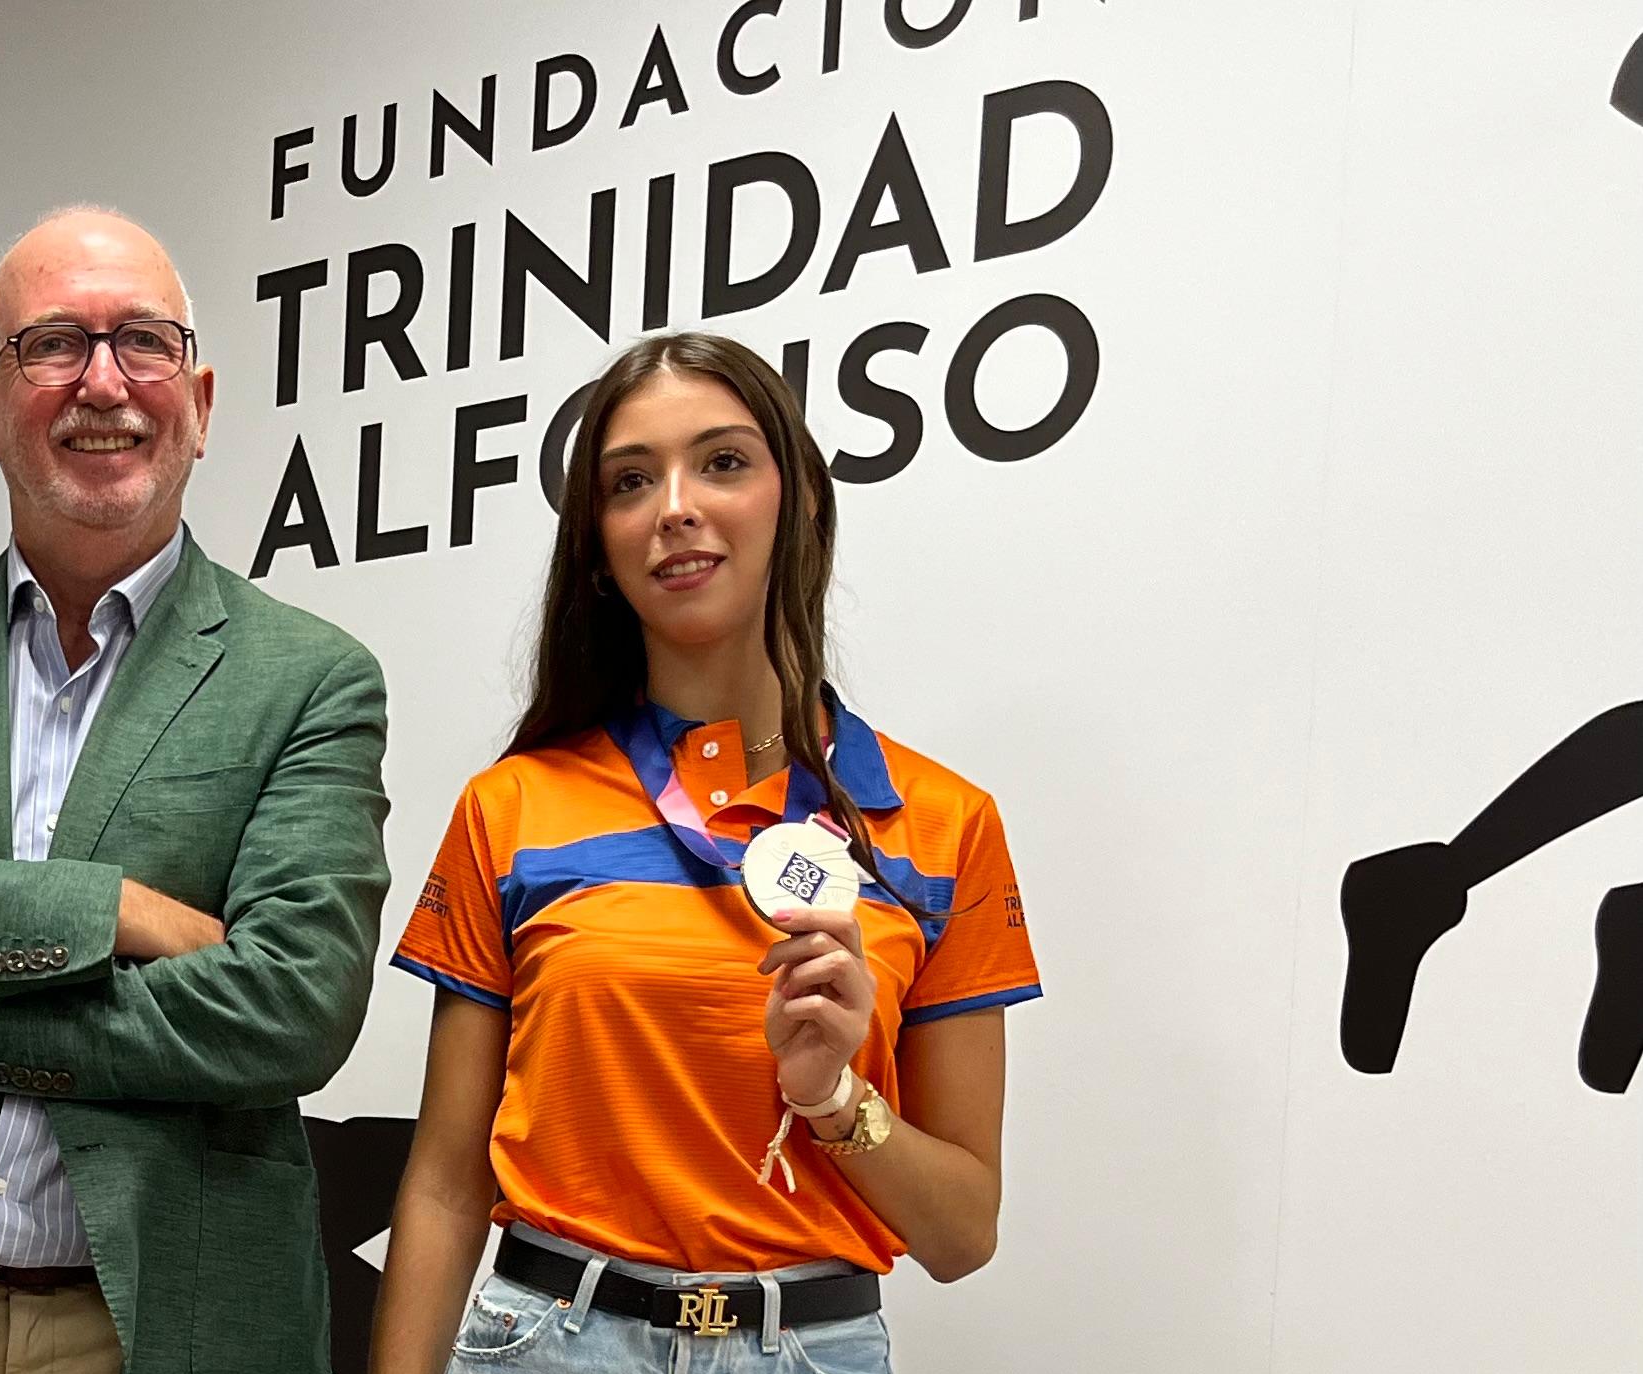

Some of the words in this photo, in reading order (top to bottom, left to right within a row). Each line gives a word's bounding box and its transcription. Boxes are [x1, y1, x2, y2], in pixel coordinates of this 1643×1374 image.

[256, 80, 1114, 408] TRINIDAD
[270, 0, 1106, 220] FUNDACI
[248, 293, 1100, 580] ALFSO
